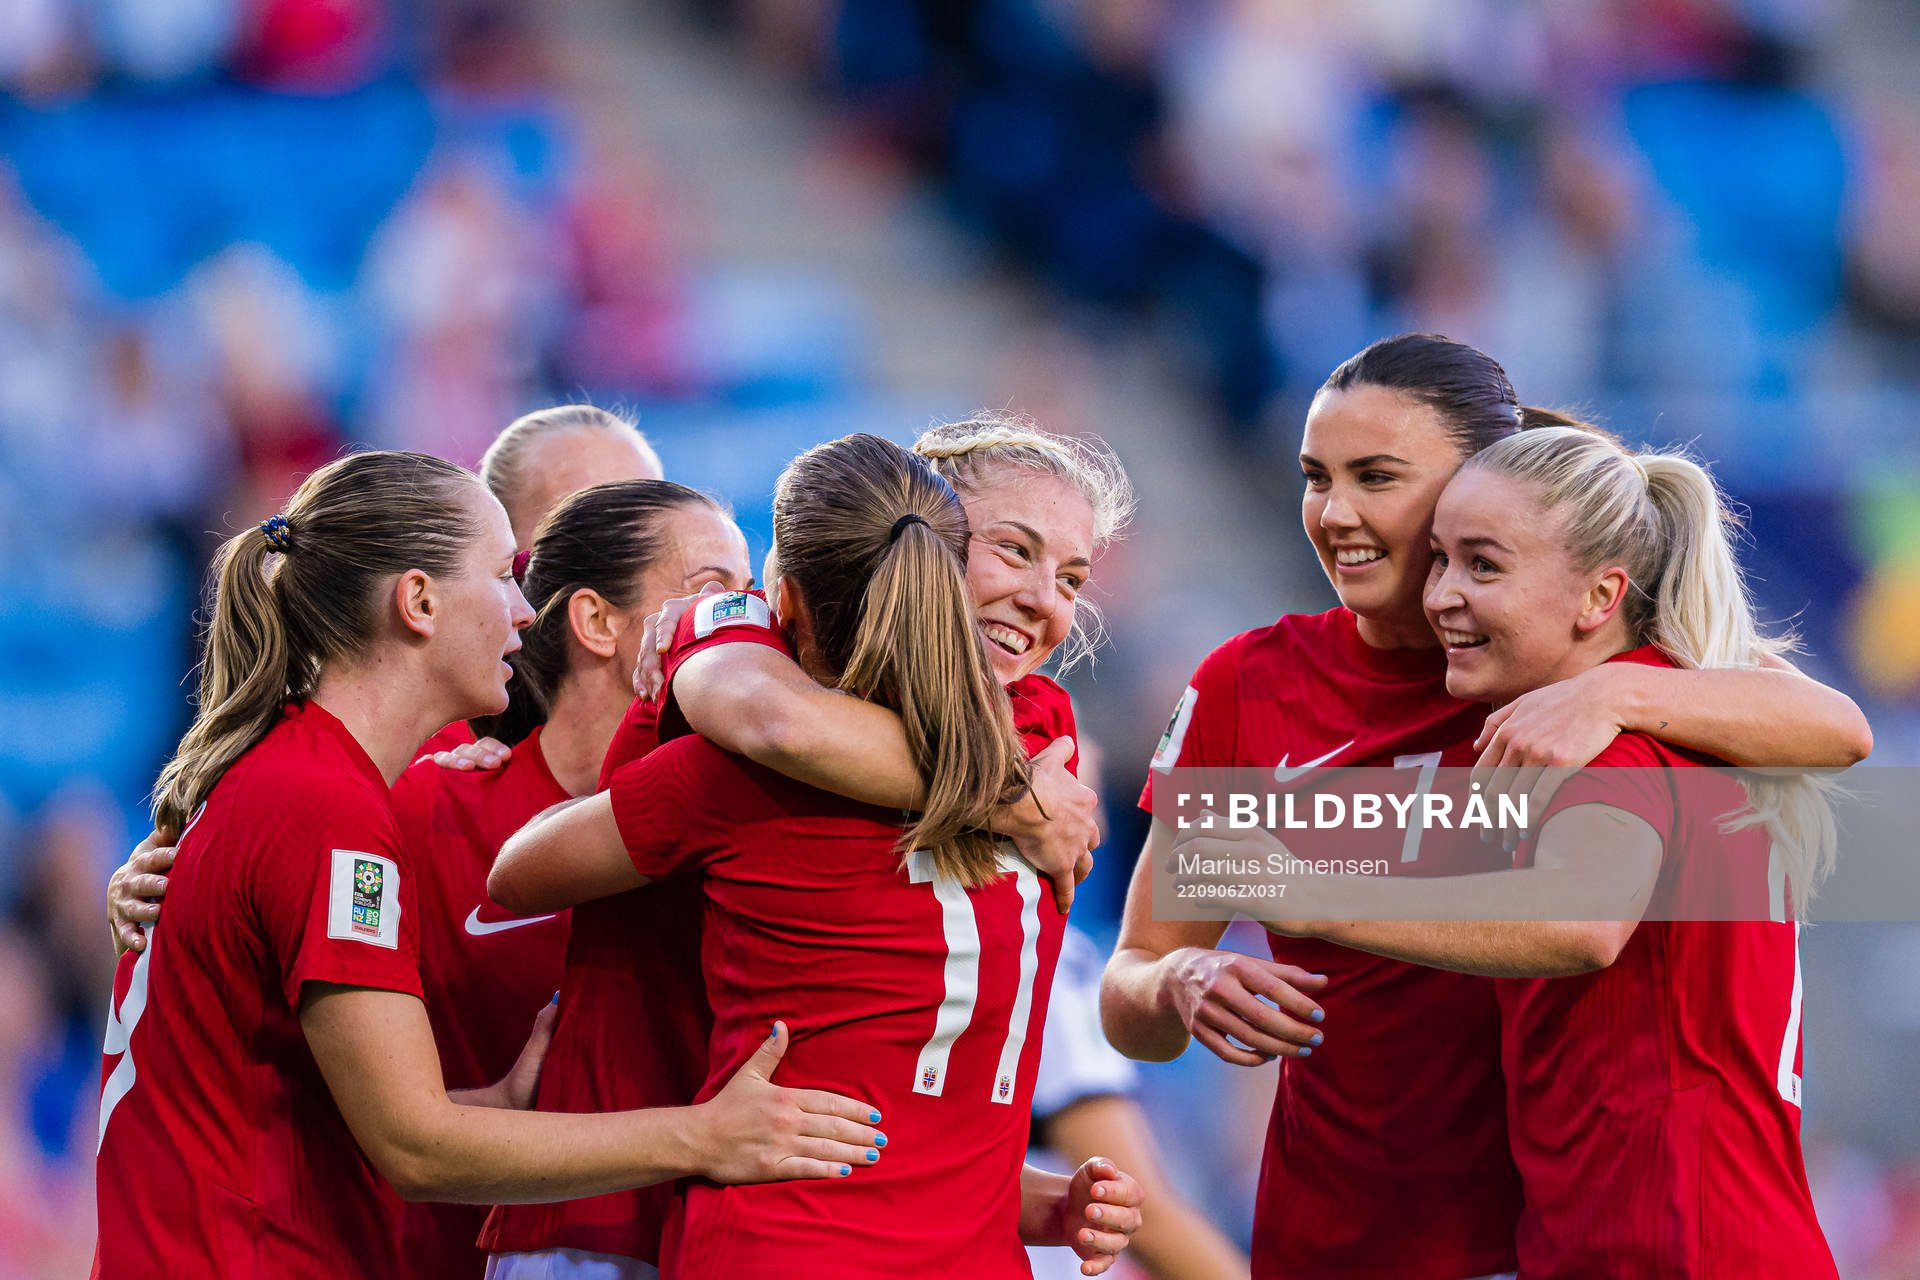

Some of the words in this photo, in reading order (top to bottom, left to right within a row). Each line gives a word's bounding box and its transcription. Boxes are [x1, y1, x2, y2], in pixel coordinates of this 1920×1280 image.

[1393, 751, 1442, 863] 7
[353, 906, 365, 915] AU
[906, 840, 1041, 1104] 11
